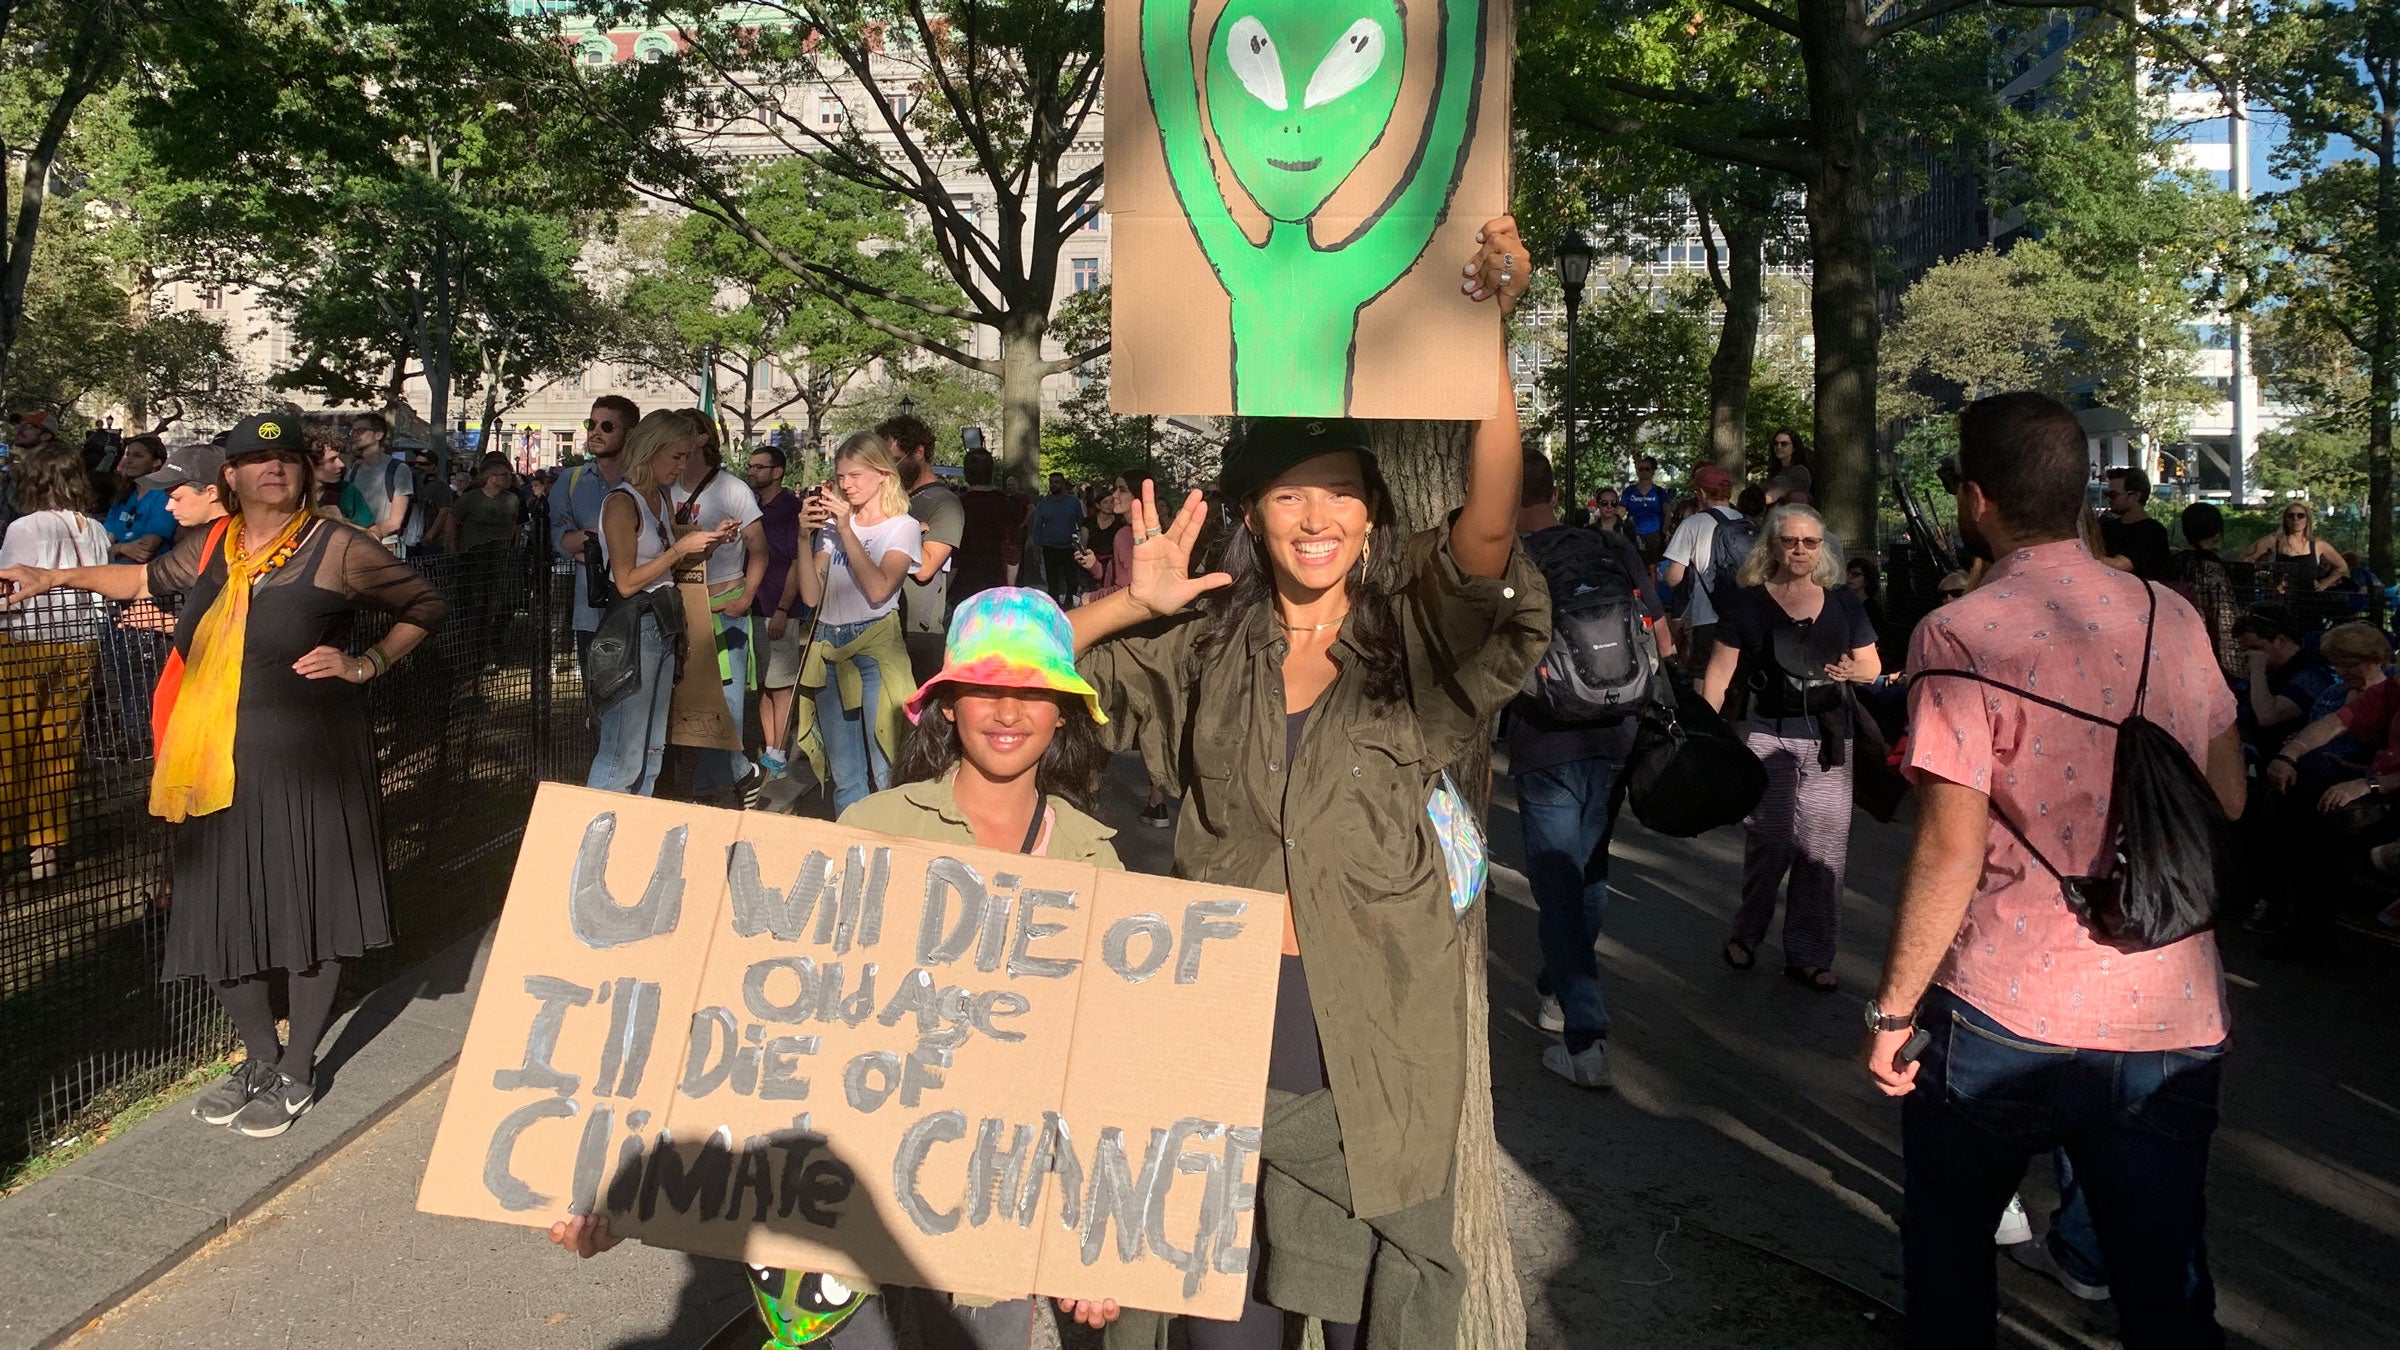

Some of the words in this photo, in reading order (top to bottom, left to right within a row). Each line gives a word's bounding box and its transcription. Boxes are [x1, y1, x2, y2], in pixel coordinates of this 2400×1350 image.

[569, 811, 689, 950] U
[726, 838, 893, 957] Will
[1102, 899, 1248, 985] OF
[492, 974, 661, 1099] I'll
[843, 1046, 954, 1114] OF
[877, 967, 1031, 1049] Age
[893, 1109, 1263, 1300] CHANGE
